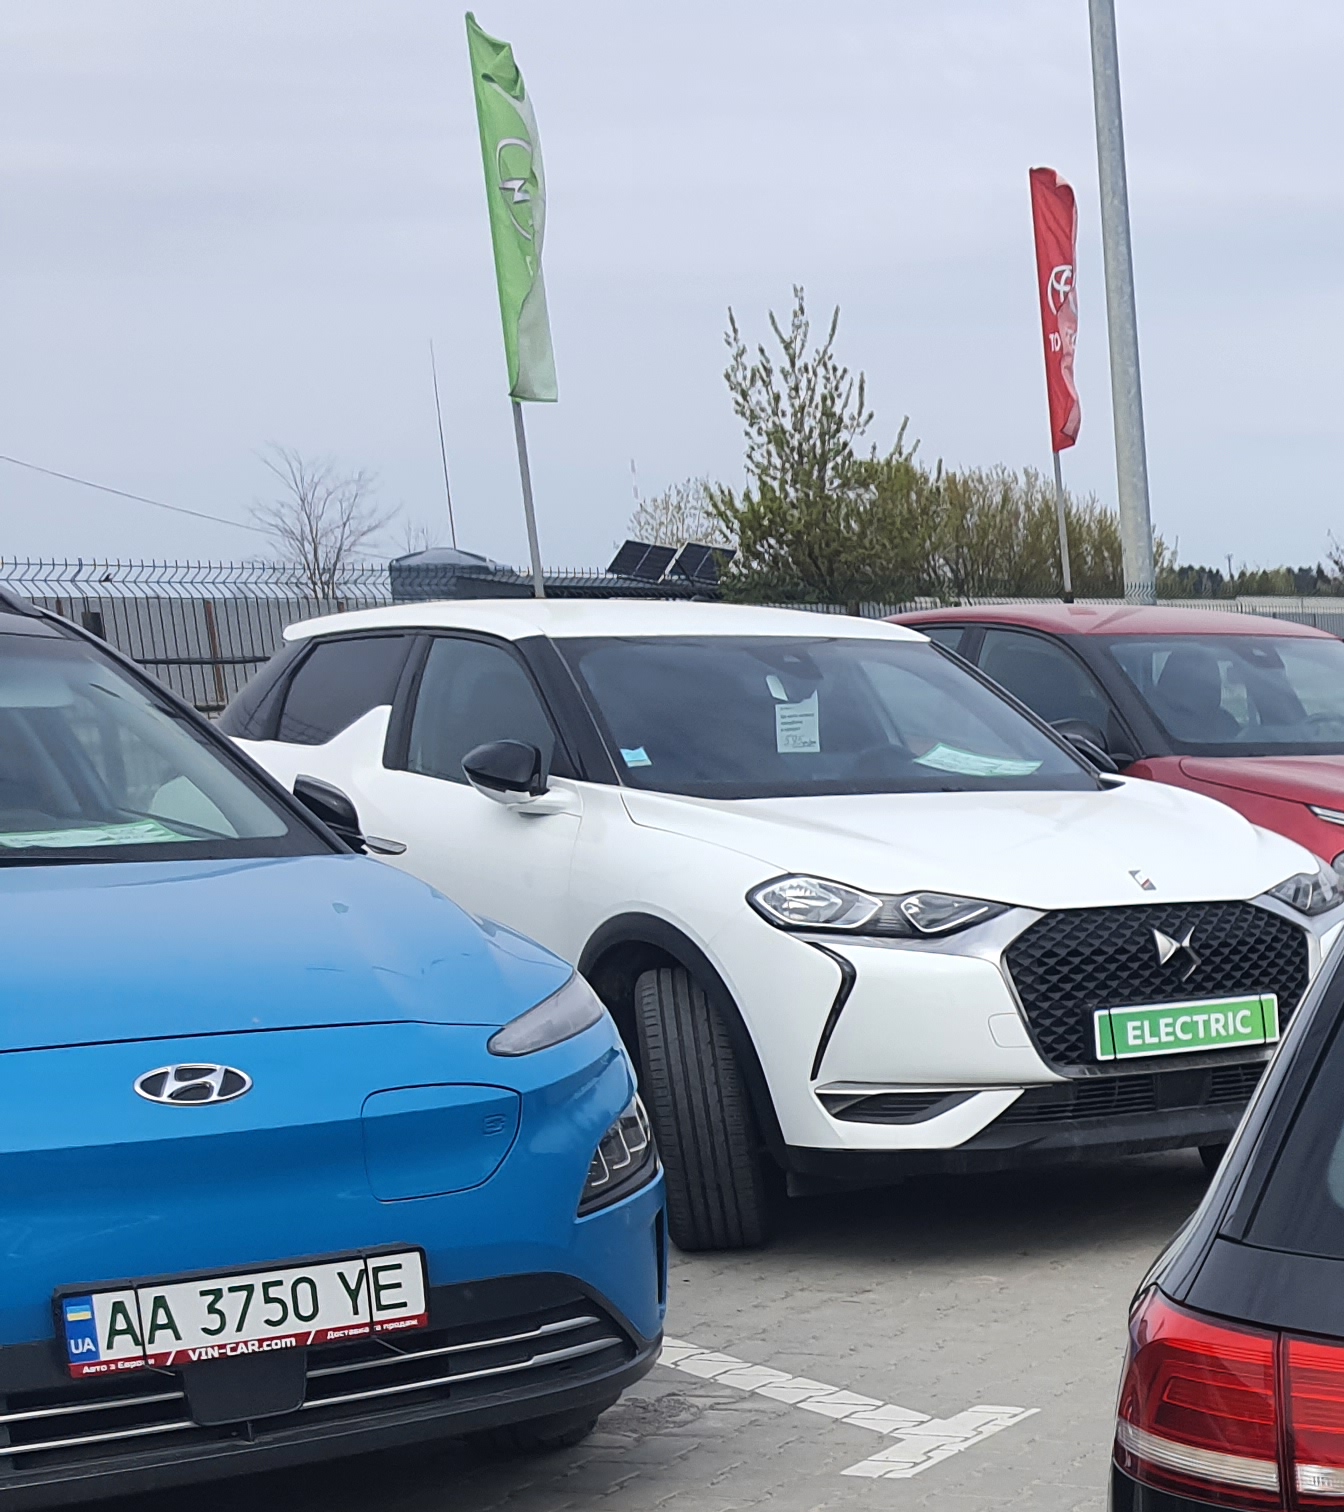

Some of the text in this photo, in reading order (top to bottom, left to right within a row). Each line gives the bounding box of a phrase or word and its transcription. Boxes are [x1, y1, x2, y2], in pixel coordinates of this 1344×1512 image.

[1126, 1009, 1252, 1046] ELECTRIC
[106, 1263, 408, 1350] AA 3750 YE
[70, 1337, 96, 1354] UA
[188, 1337, 296, 1361] VIN-CAR.com
[82, 1363, 107, 1374] Авто
